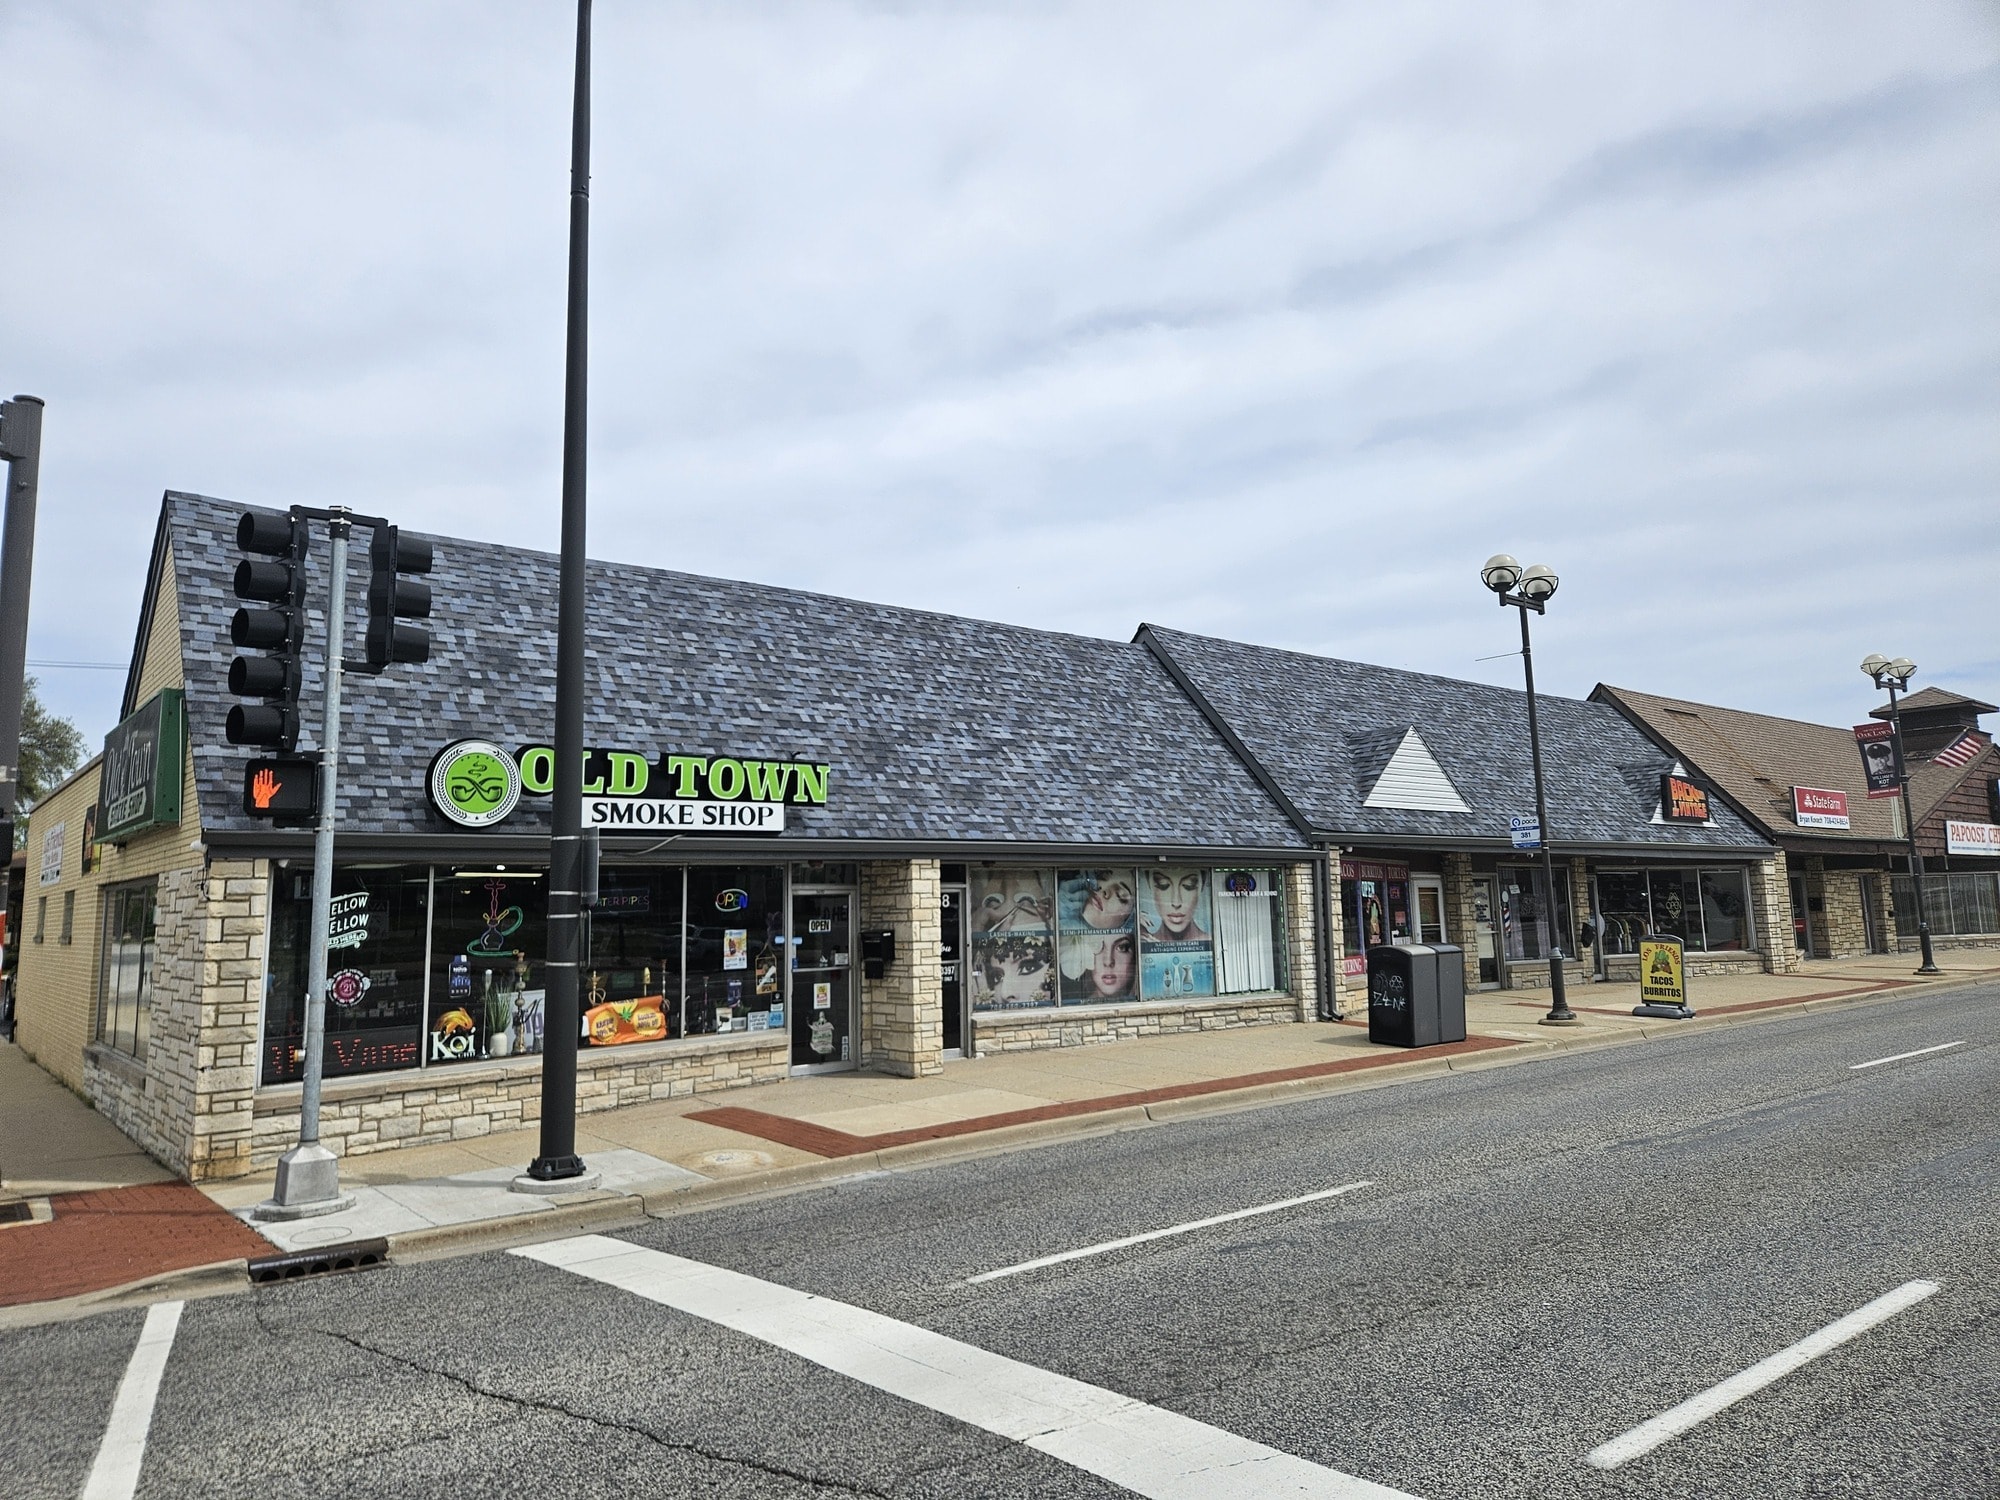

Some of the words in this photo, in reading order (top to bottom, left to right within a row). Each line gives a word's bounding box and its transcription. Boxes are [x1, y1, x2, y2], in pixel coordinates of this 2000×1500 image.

[1873, 729, 1892, 737] LAWN
[520, 747, 649, 795] OLD
[668, 755, 831, 804] TOWN
[591, 802, 695, 826] SMOKE
[702, 806, 774, 827] SHOP
[1950, 824, 1986, 843] PAPOOSE
[1340, 863, 1355, 878] COS
[1361, 864, 1384, 879] BURRITOS
[1388, 866, 1407, 879] TORTAS
[331, 896, 368, 916] ELLOW
[716, 892, 749, 909] OPEN
[329, 914, 369, 935] ELLOW
[810, 920, 830, 931] OPEN
[1642, 948, 1652, 961] LOS
[1655, 944, 1681, 965] FRIENDS
[1650, 975, 1674, 985] TACOS
[1644, 986, 1681, 998] BURRITOS
